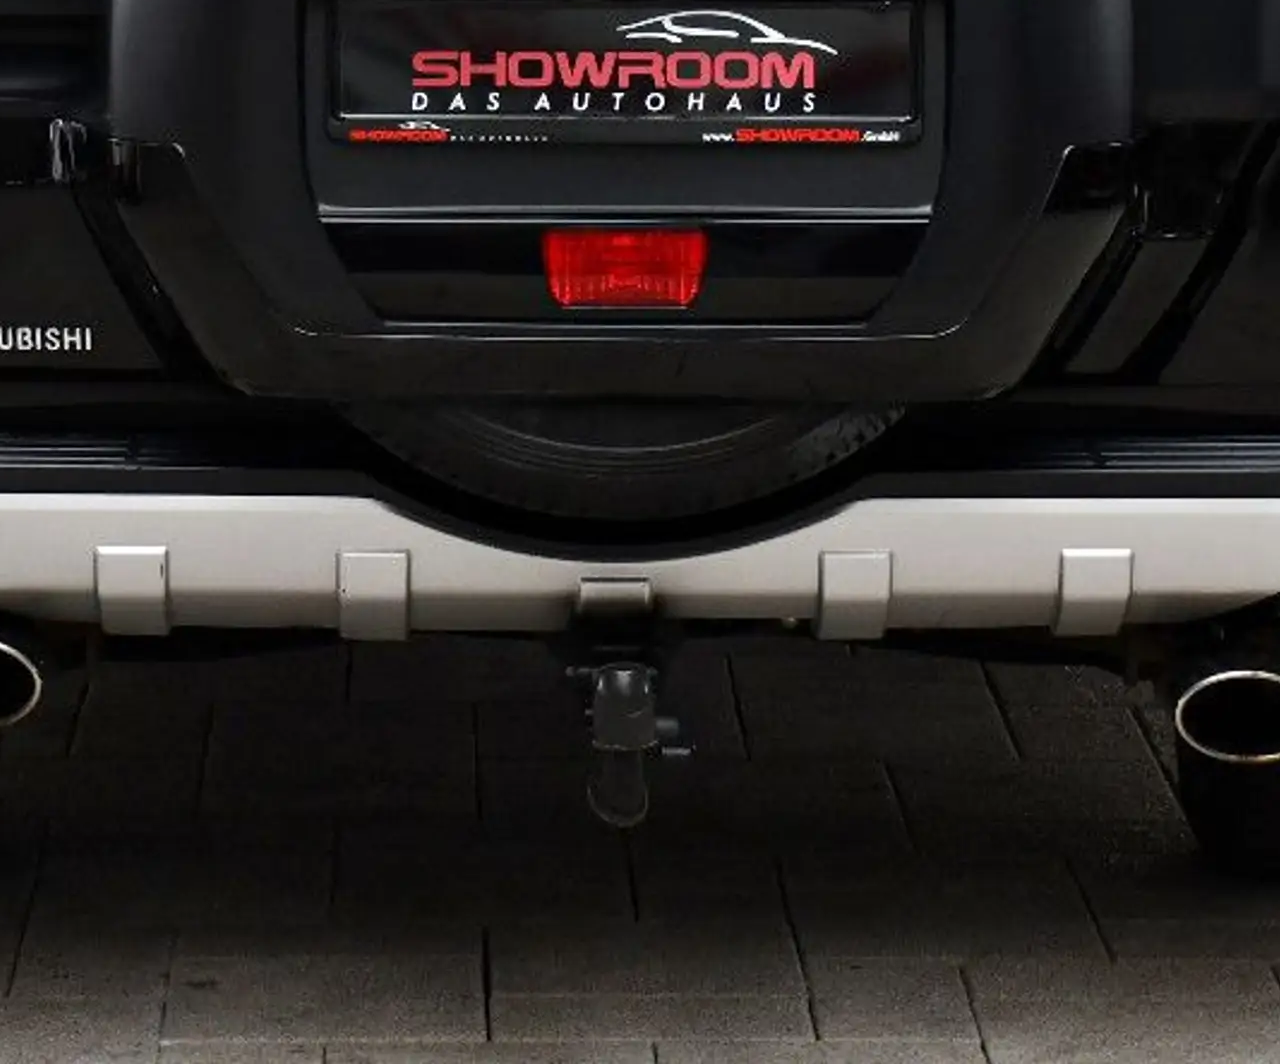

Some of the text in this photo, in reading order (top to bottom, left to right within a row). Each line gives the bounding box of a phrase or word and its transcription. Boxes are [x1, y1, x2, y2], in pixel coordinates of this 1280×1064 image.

[411, 50, 816, 90] SHOWROOM
[411, 91, 817, 114] DAS AUTOHAUS
